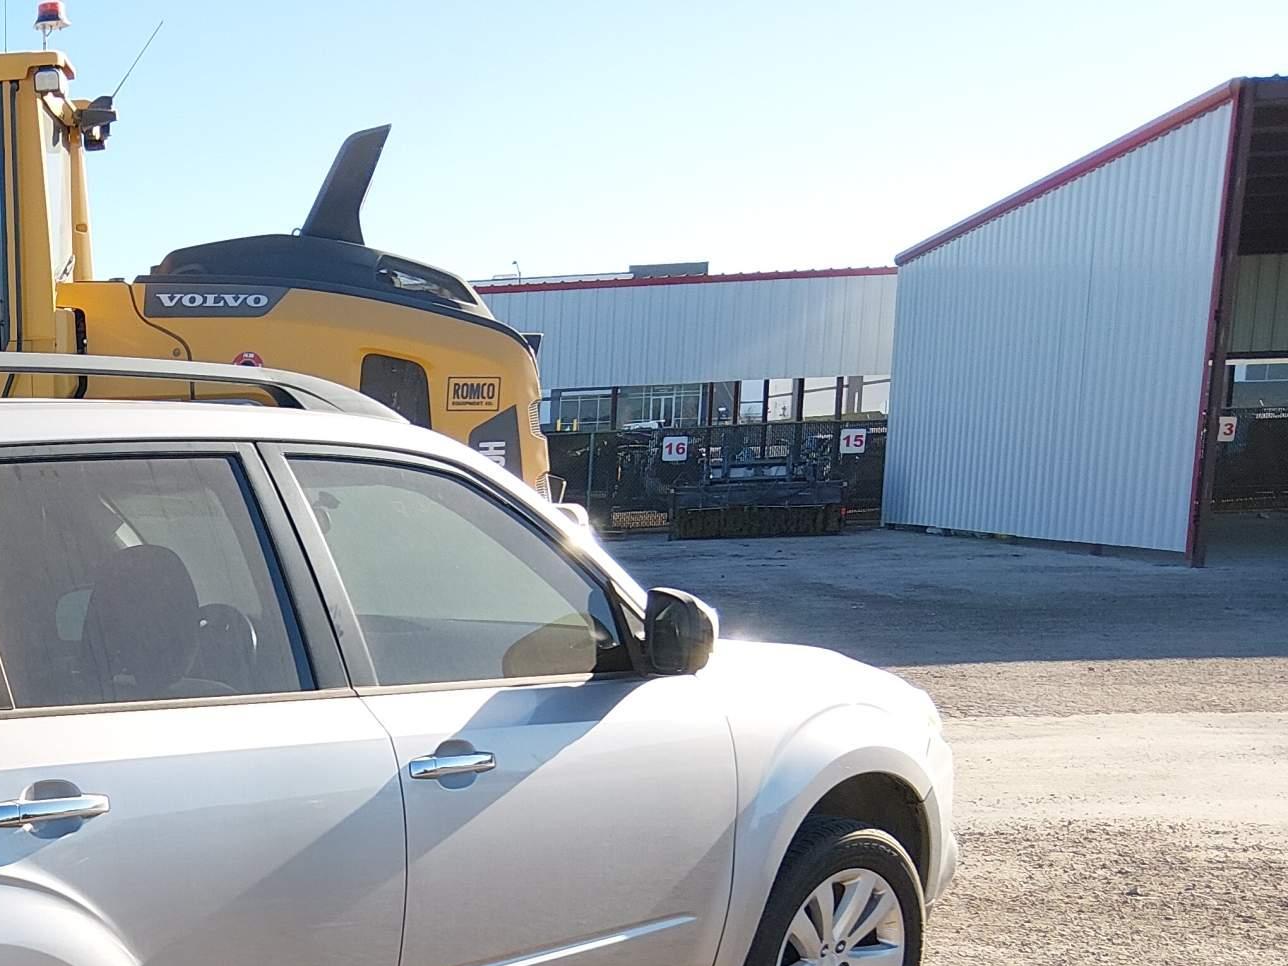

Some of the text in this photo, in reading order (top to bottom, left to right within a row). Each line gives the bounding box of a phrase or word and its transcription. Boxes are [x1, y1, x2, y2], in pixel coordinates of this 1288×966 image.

[155, 293, 269, 307] VOLVO
[452, 383, 496, 400] ROMCO
[842, 434, 865, 448] 15
[664, 442, 687, 456] 16
